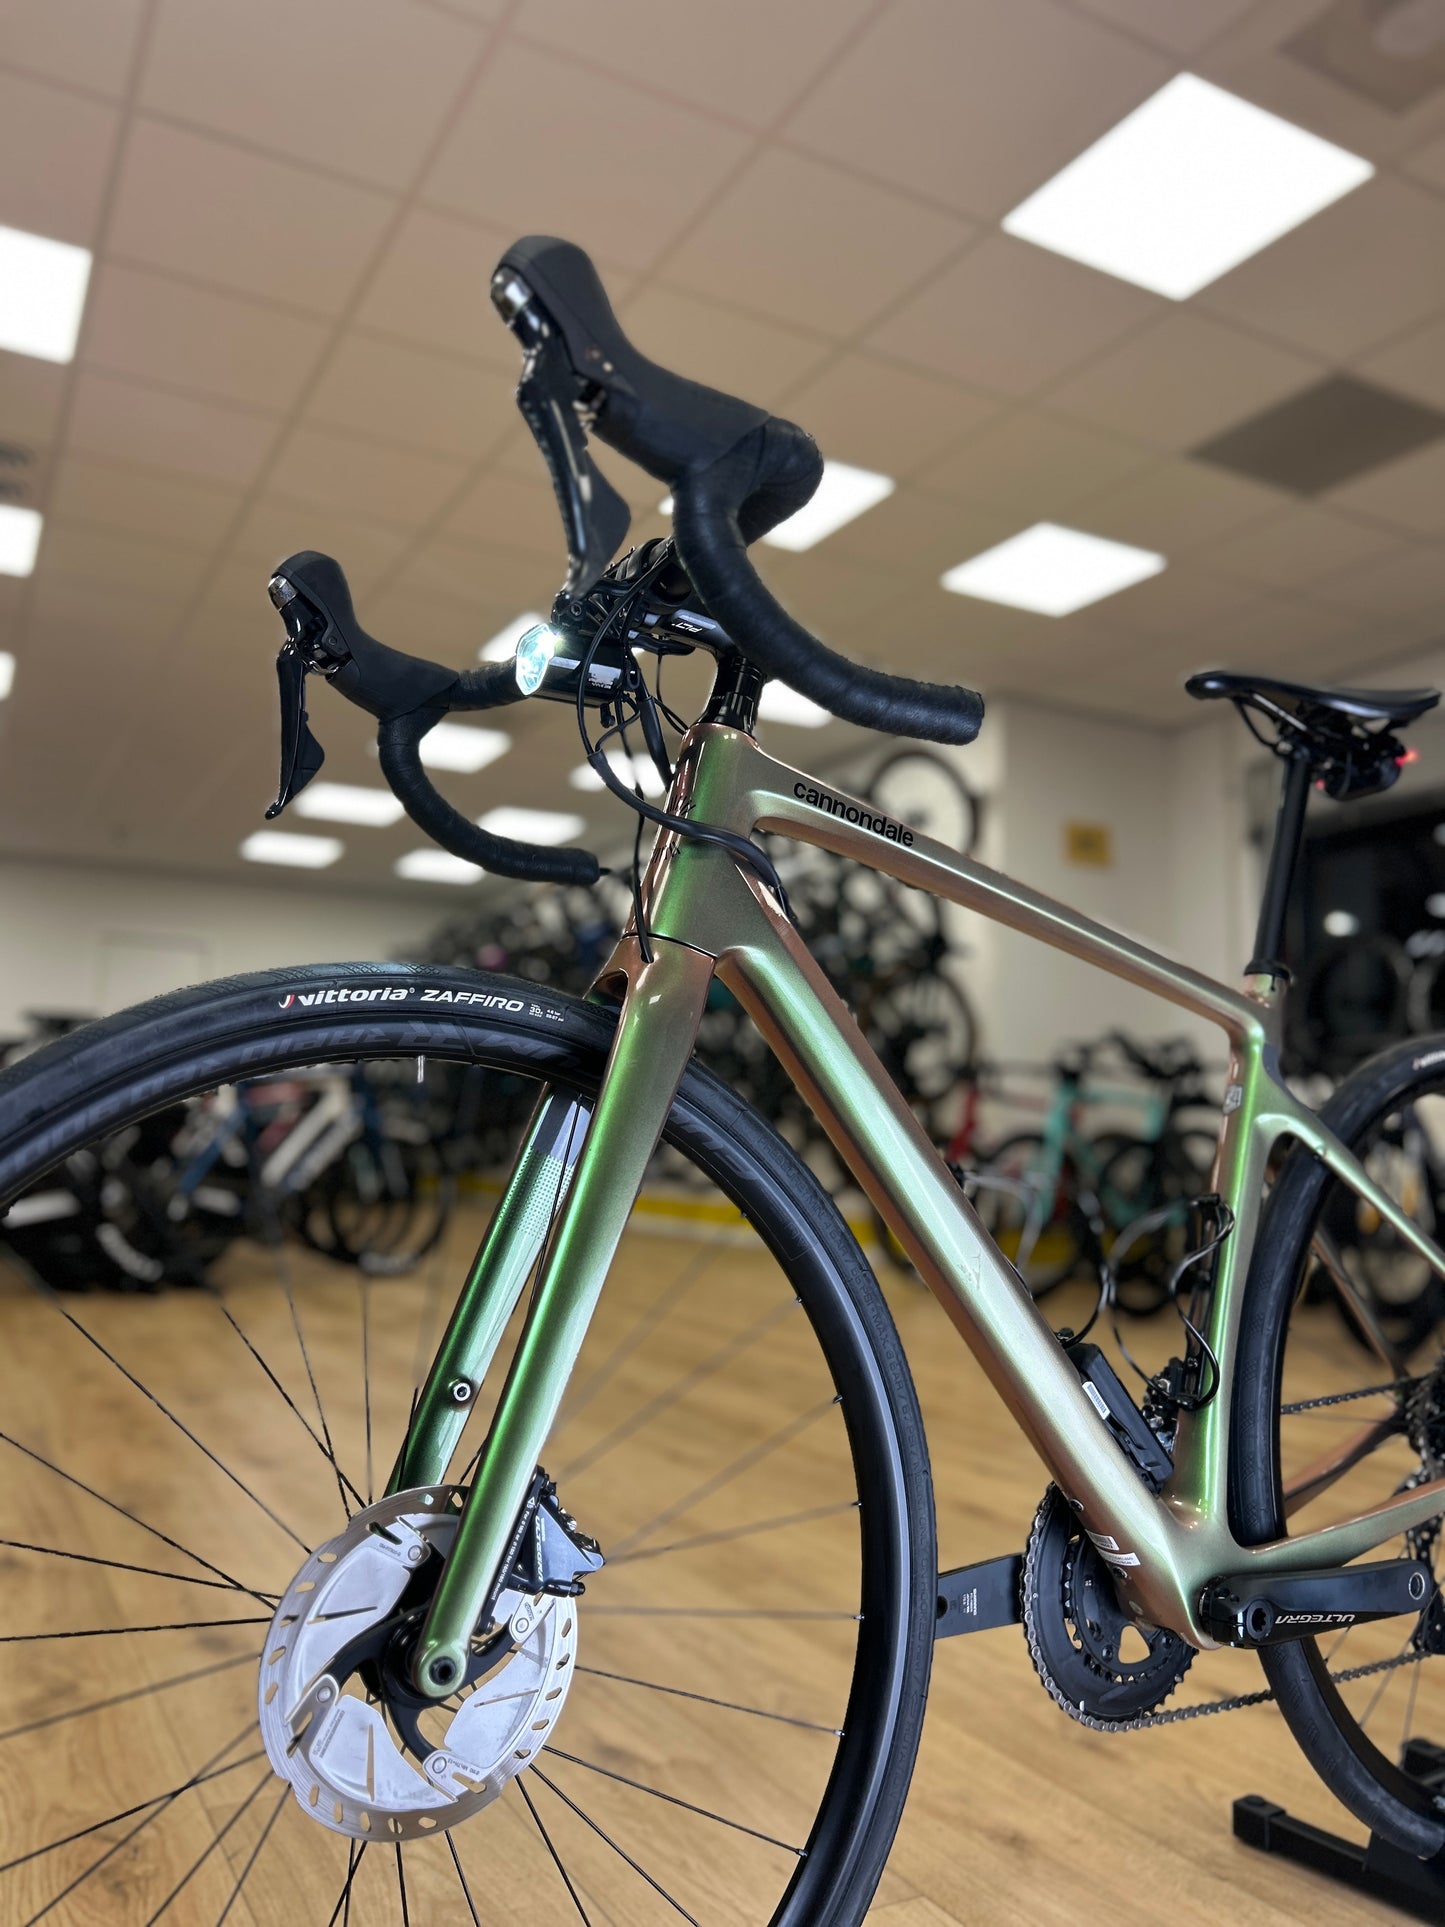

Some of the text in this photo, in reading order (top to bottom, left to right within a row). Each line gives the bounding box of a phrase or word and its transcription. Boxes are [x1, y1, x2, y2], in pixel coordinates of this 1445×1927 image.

[793, 782, 914, 847] cannondale
[420, 989, 524, 1012] ZAFFIRO
[535, 1515, 544, 1582] ULTEGRA
[916, 1581, 929, 1641] HOOKED
[1275, 1614, 1356, 1624] ULTEGRA
